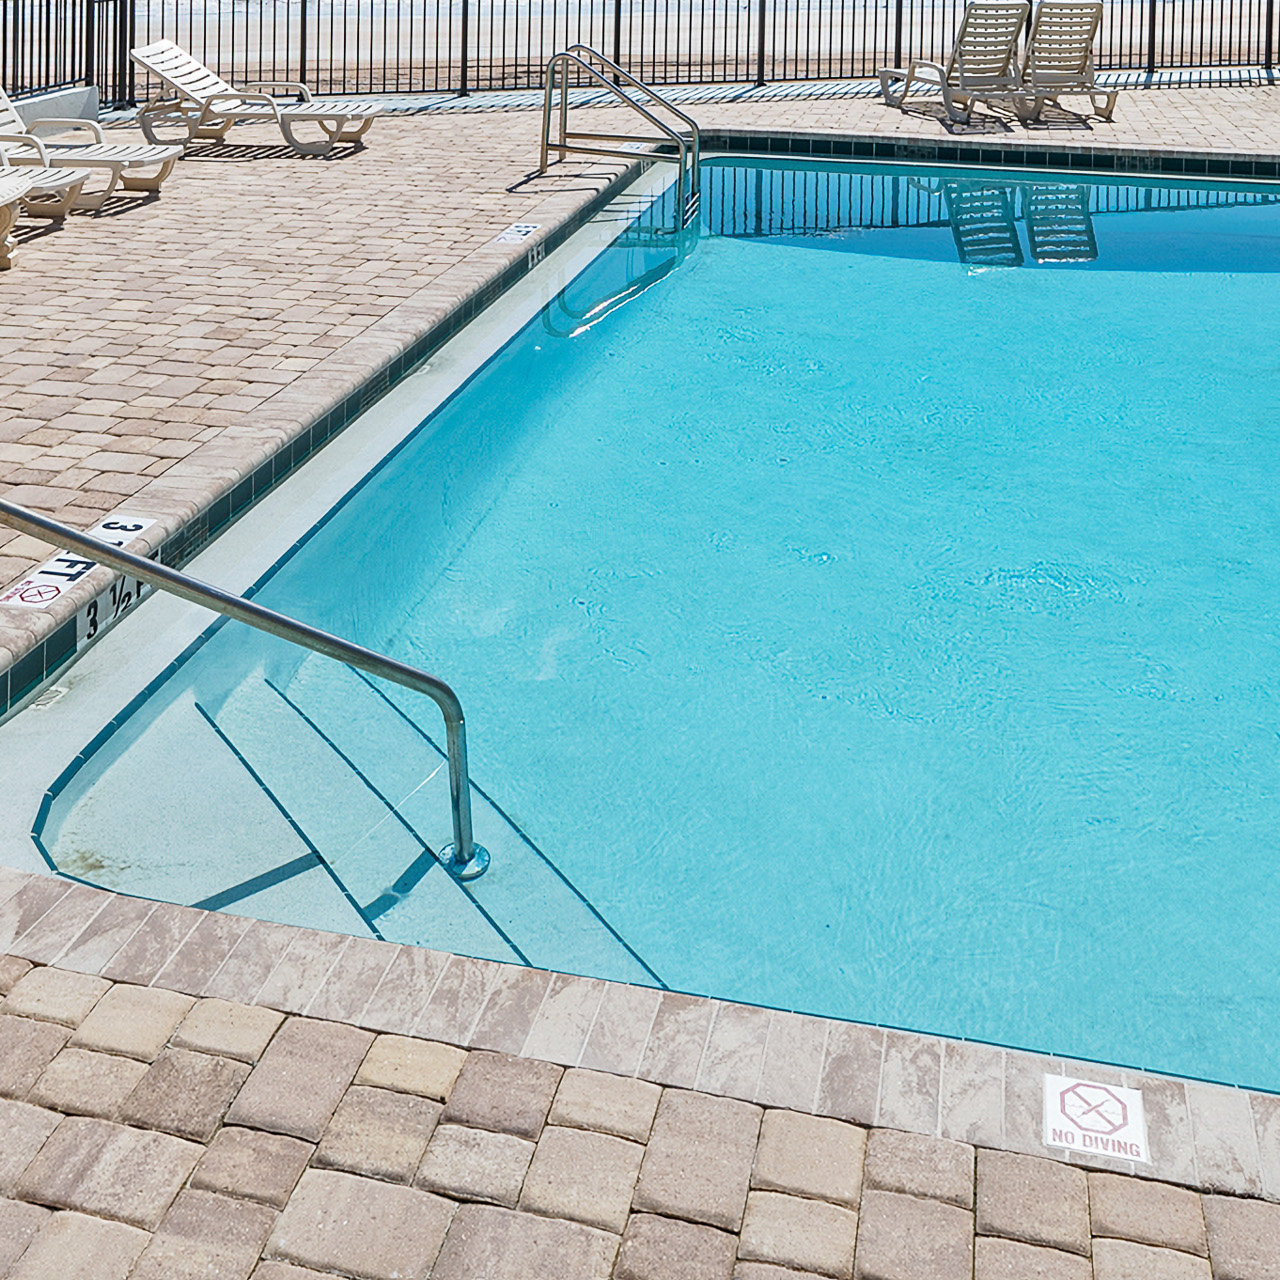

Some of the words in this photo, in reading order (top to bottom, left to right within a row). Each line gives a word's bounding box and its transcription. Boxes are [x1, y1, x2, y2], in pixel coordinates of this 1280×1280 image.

[102, 520, 144, 532] 3
[38, 558, 98, 582] FT
[86, 599, 99, 640] 3
[1052, 1128, 1075, 1145] NO
[1082, 1133, 1141, 1158] DIVING
